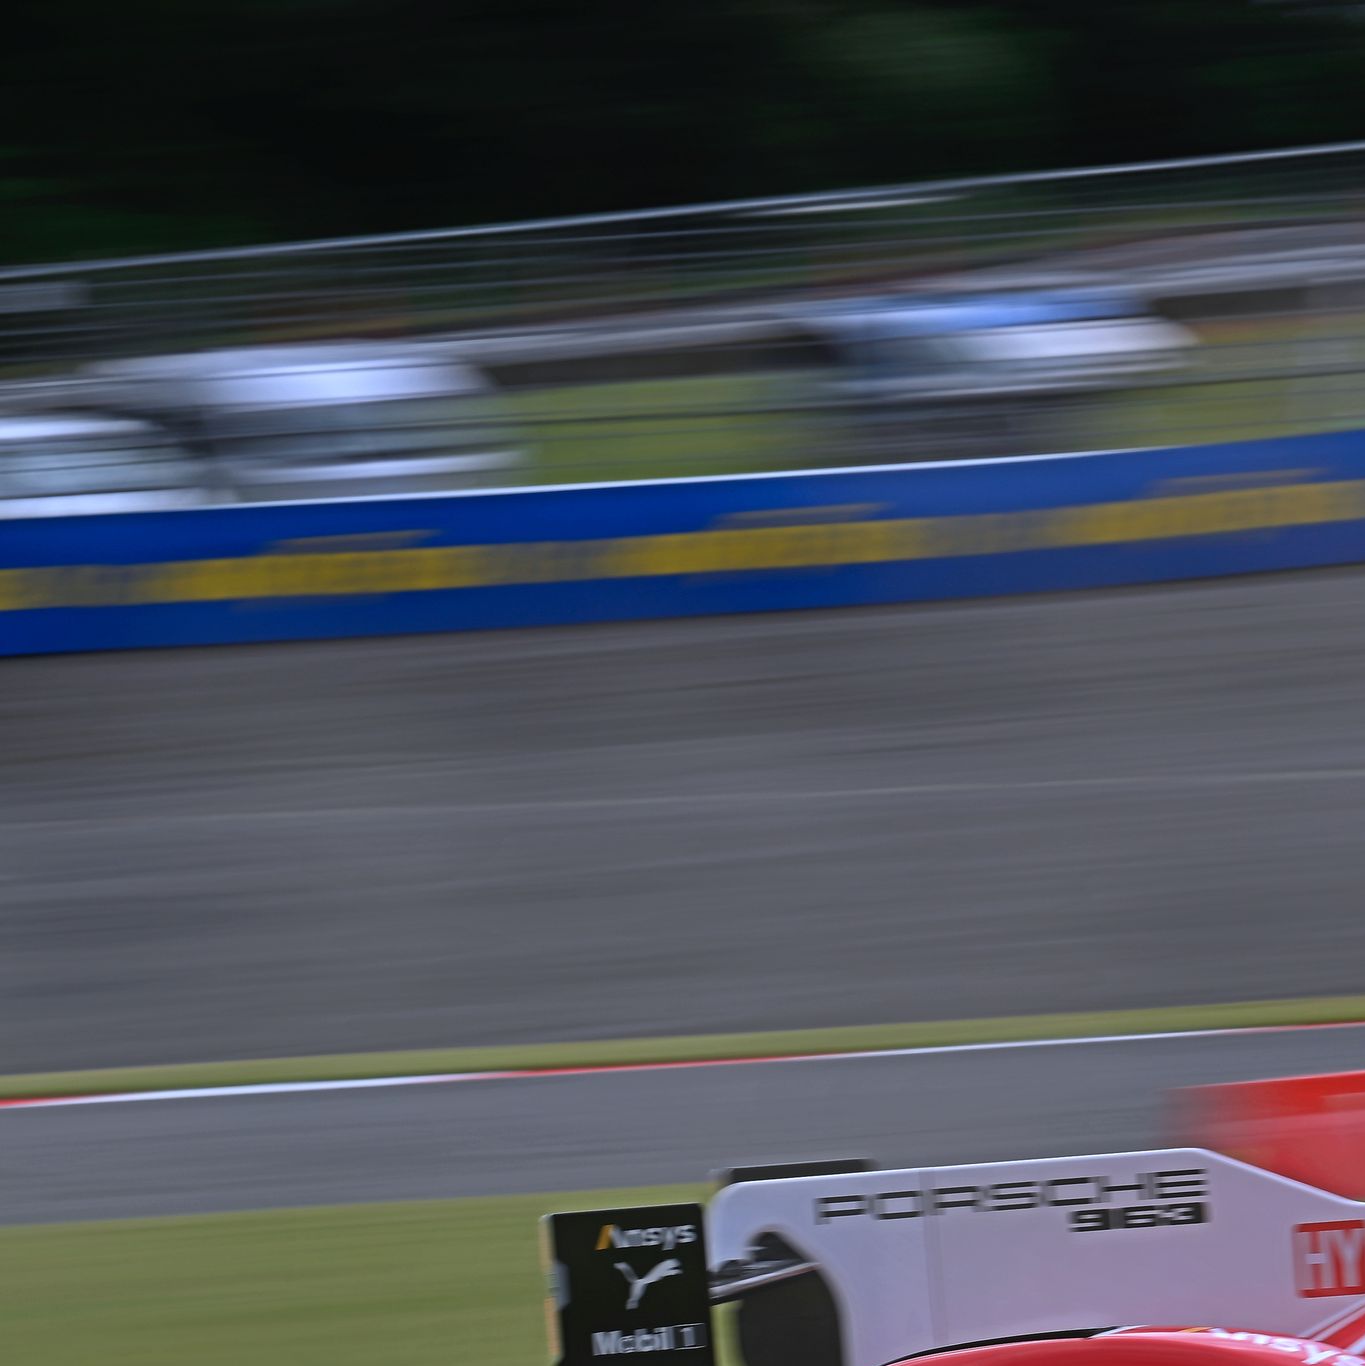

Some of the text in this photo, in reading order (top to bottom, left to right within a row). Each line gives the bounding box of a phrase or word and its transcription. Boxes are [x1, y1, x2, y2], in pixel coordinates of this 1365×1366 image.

[814, 1168, 1208, 1225] PORSCHE
[1069, 1201, 1208, 1232] 963
[596, 1223, 697, 1251] Ansys
[591, 1326, 674, 1356] Mobil
